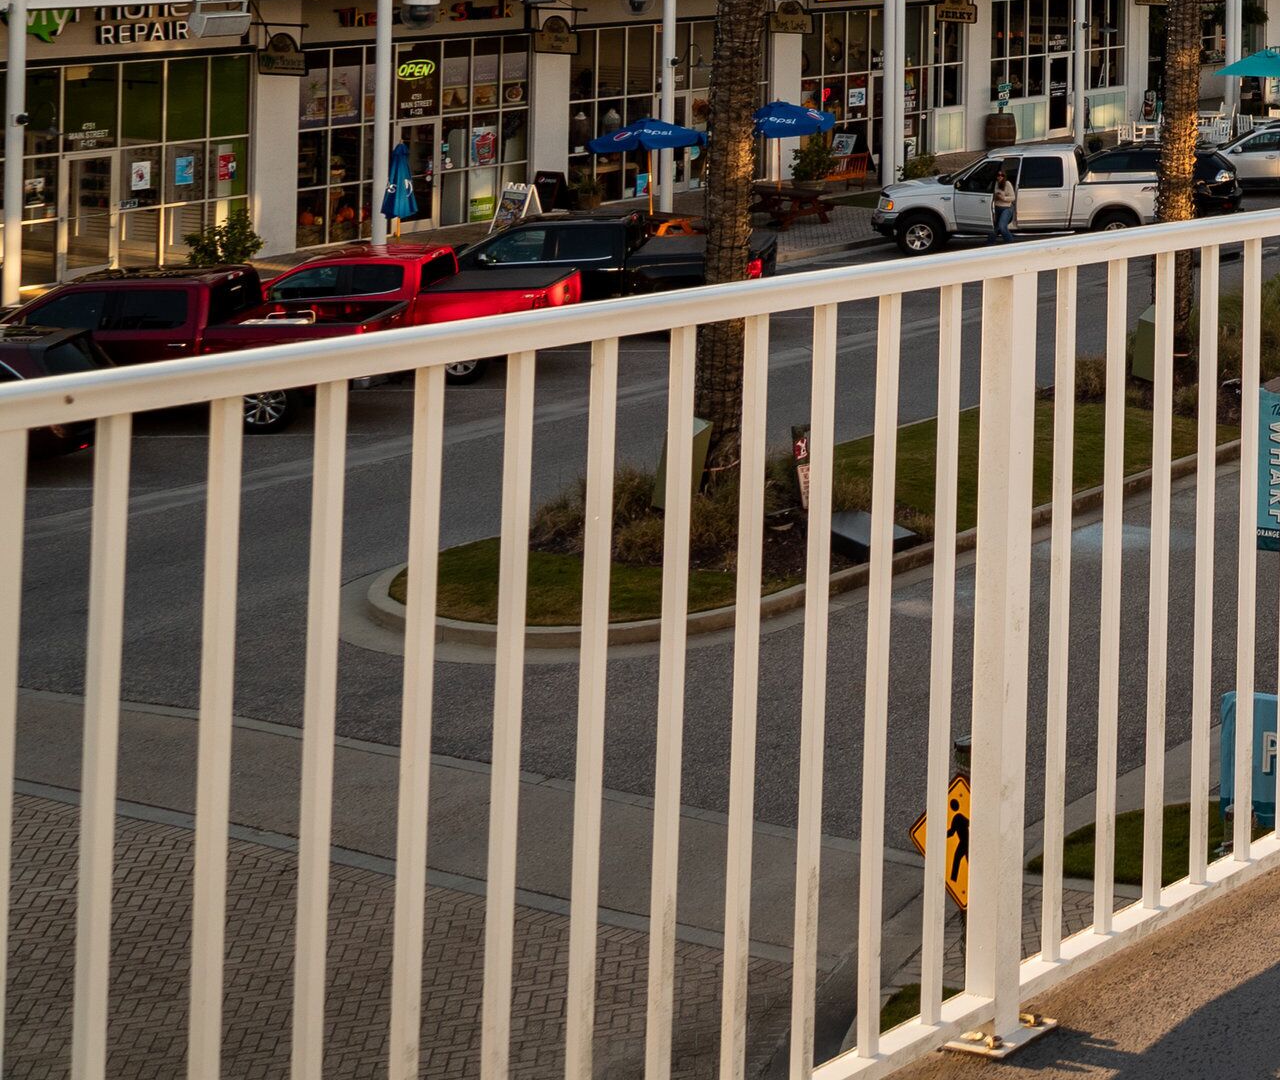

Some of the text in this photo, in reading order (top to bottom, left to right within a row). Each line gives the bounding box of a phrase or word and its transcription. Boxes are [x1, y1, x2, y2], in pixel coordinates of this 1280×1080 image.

[938, 10, 973, 20] JERKY
[101, 20, 190, 45] REPAIR
[398, 63, 431, 77] OPEN
[632, 128, 673, 136] pepsi
[1257, 527, 1280, 538] ORANGE
